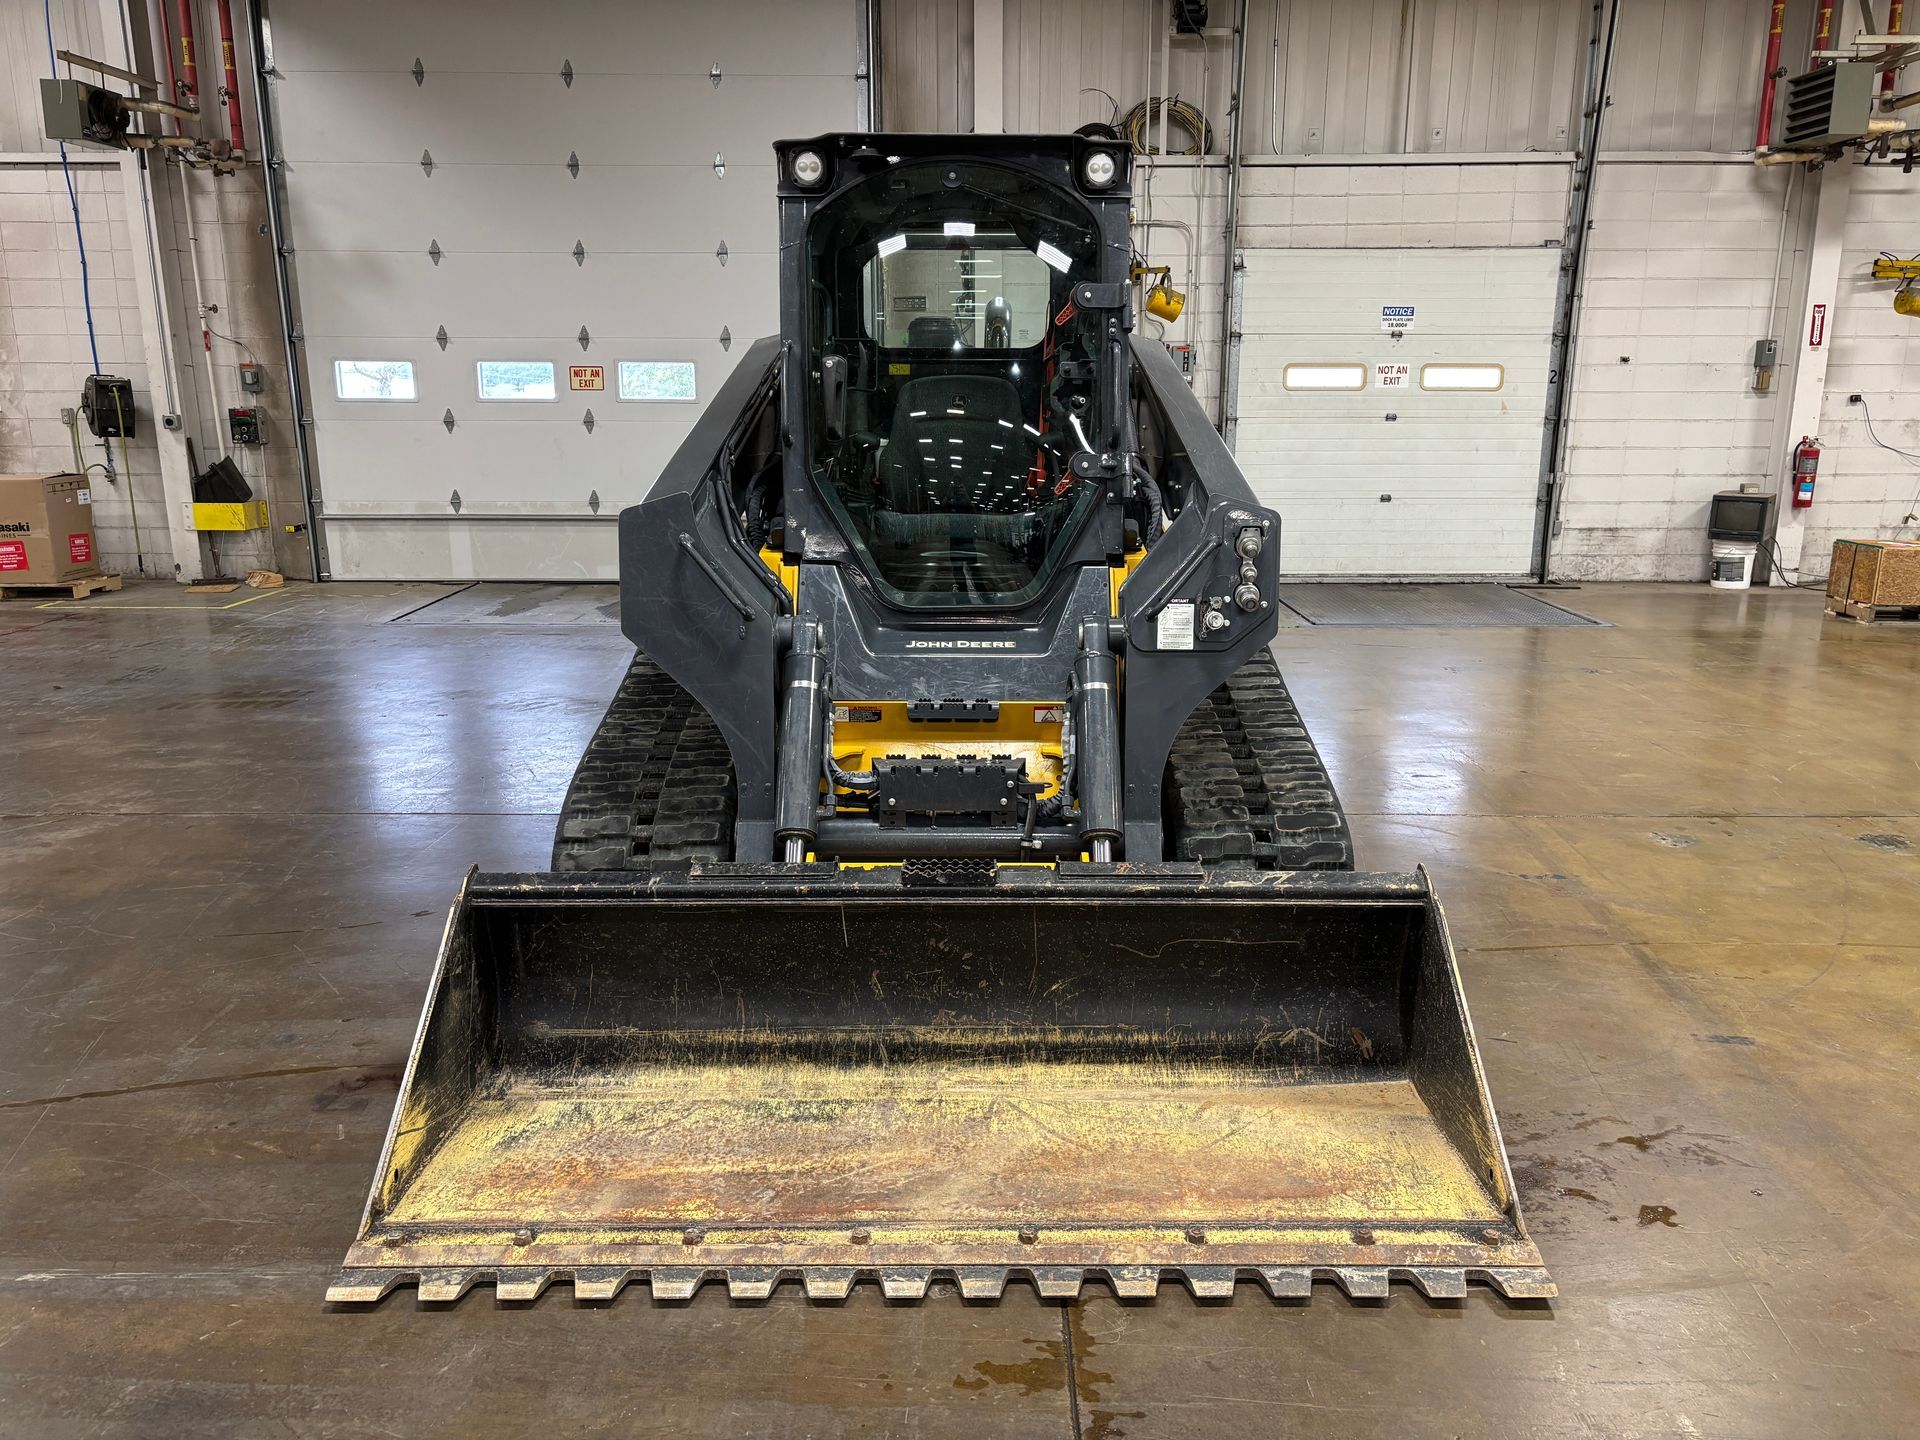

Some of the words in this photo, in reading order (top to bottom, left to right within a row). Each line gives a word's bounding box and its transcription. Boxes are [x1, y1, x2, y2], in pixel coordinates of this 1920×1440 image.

[573, 369, 588, 378] NOT
[590, 369, 600, 378] AN
[1378, 366, 1394, 375] NOT
[1396, 366, 1407, 375] AN
[1549, 369, 1557, 384] 2
[579, 379, 595, 388] EXIT
[1383, 377, 1401, 386] EXIT
[905, 640, 953, 648] JOHN
[957, 640, 1016, 648] DEERE
